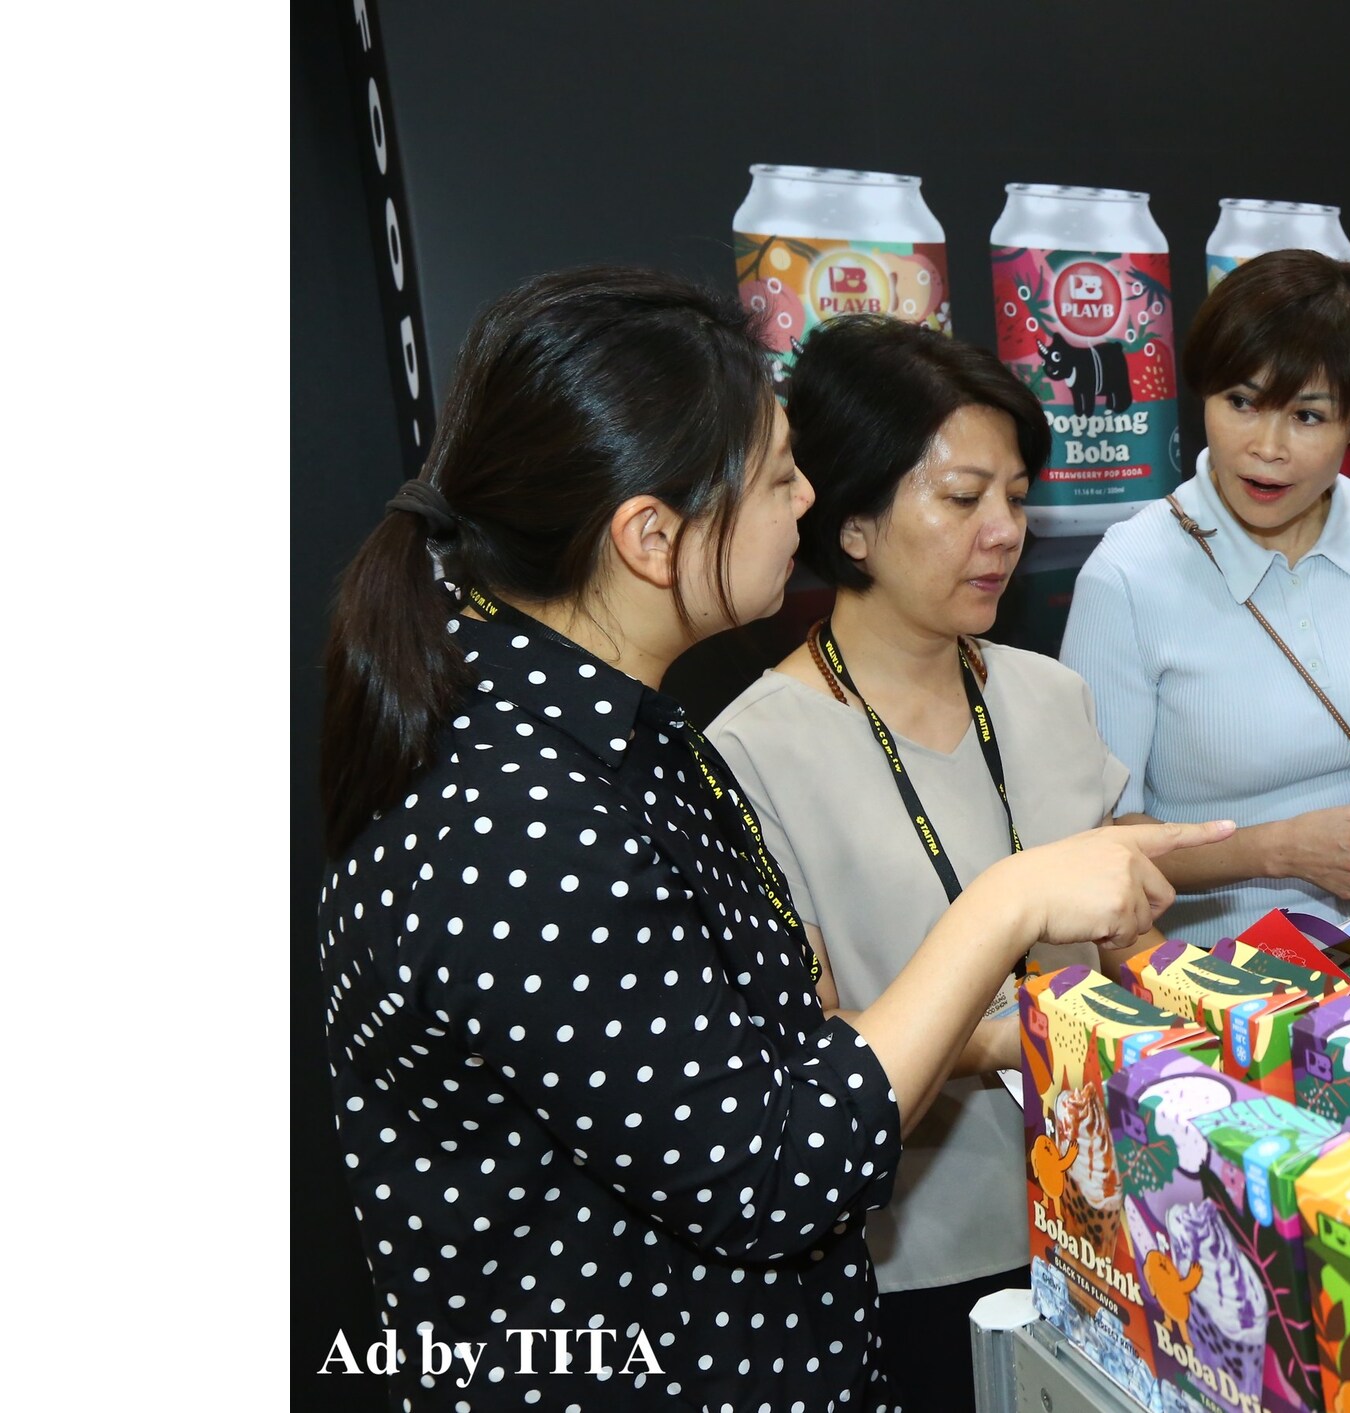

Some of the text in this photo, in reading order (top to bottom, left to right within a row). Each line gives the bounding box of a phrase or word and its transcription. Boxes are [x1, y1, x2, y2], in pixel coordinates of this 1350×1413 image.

[819, 297, 881, 314] PLAYB
[1061, 303, 1115, 320] PLAYB
[1065, 440, 1130, 464] Boba
[1049, 470, 1101, 480] STRAWBERRY
[1104, 469, 1119, 478] POP
[825, 640, 839, 666] TAITRA
[866, 702, 902, 773] ows.com.tw
[977, 711, 991, 743] TAITRA
[920, 823, 940, 856] TAITRA
[1033, 1200, 1145, 1306] Boba Drink
[1054, 1256, 1119, 1315] BLACK TEA FLAVOR
[1153, 1320, 1272, 1413] Boba Dri
